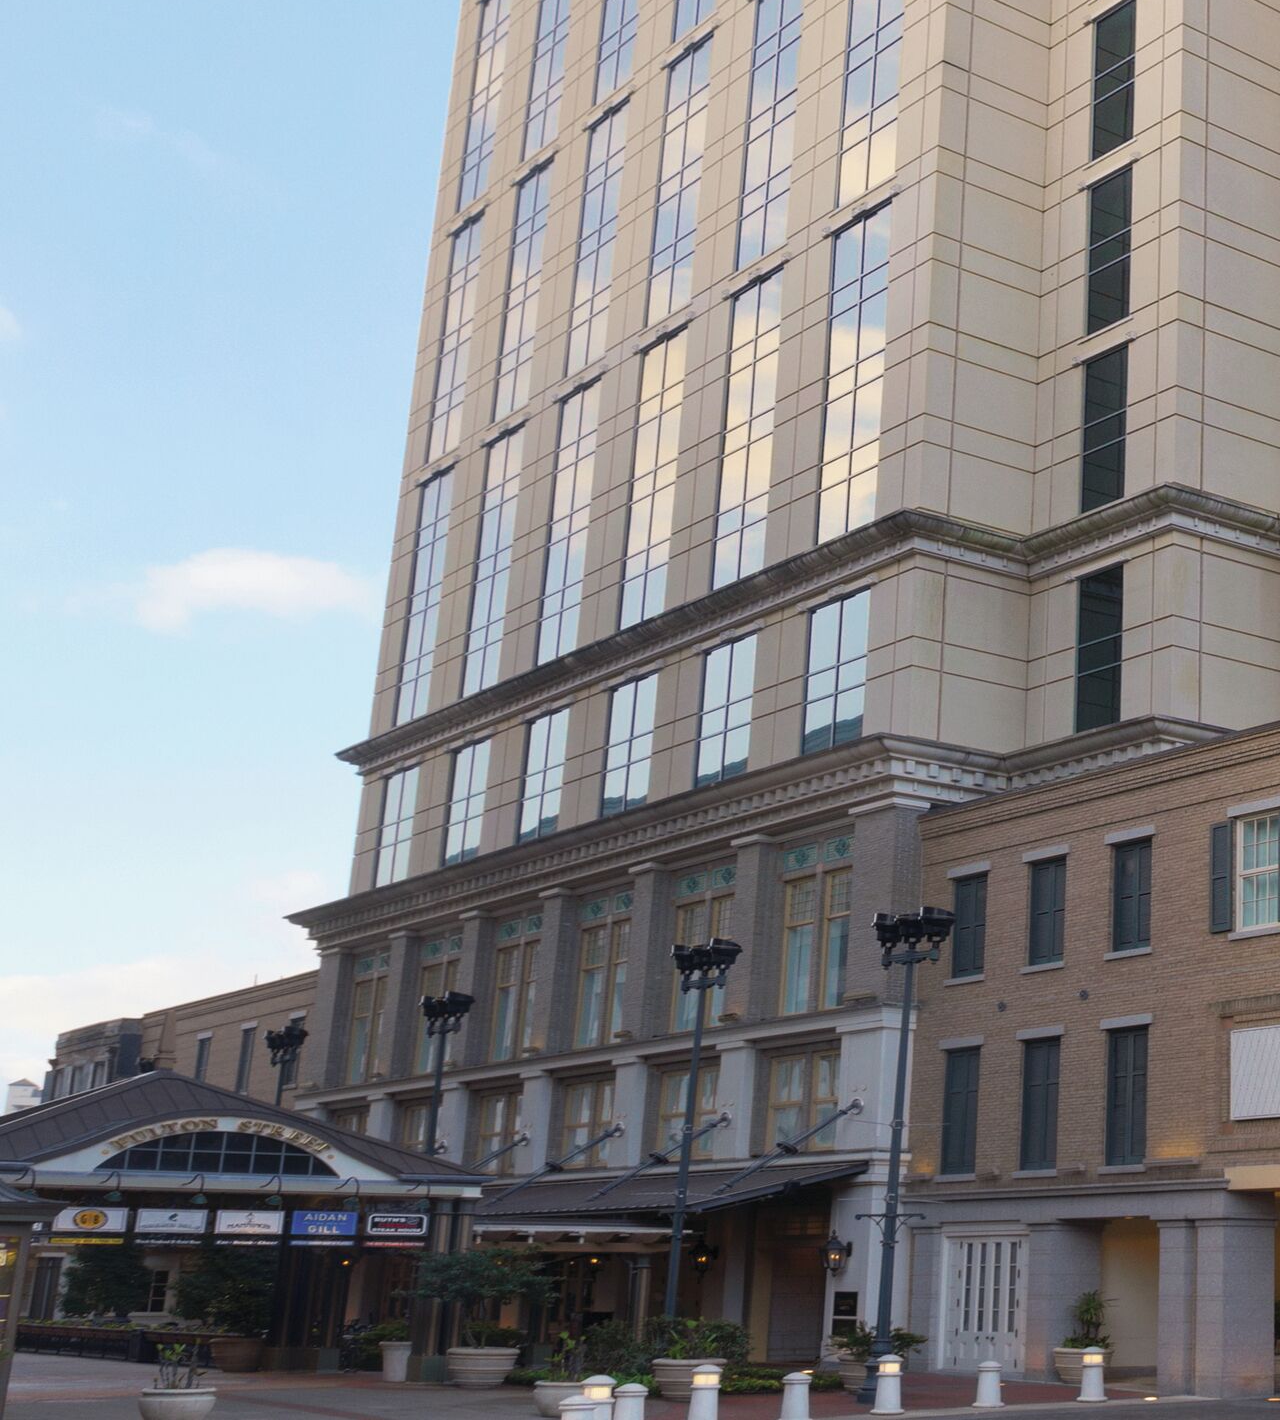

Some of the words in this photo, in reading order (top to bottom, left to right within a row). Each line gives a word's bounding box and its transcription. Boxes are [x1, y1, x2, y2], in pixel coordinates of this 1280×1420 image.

[109, 1118, 219, 1150] FULTON
[304, 1213, 348, 1221] AIDAN
[308, 1225, 341, 1234] GILL
